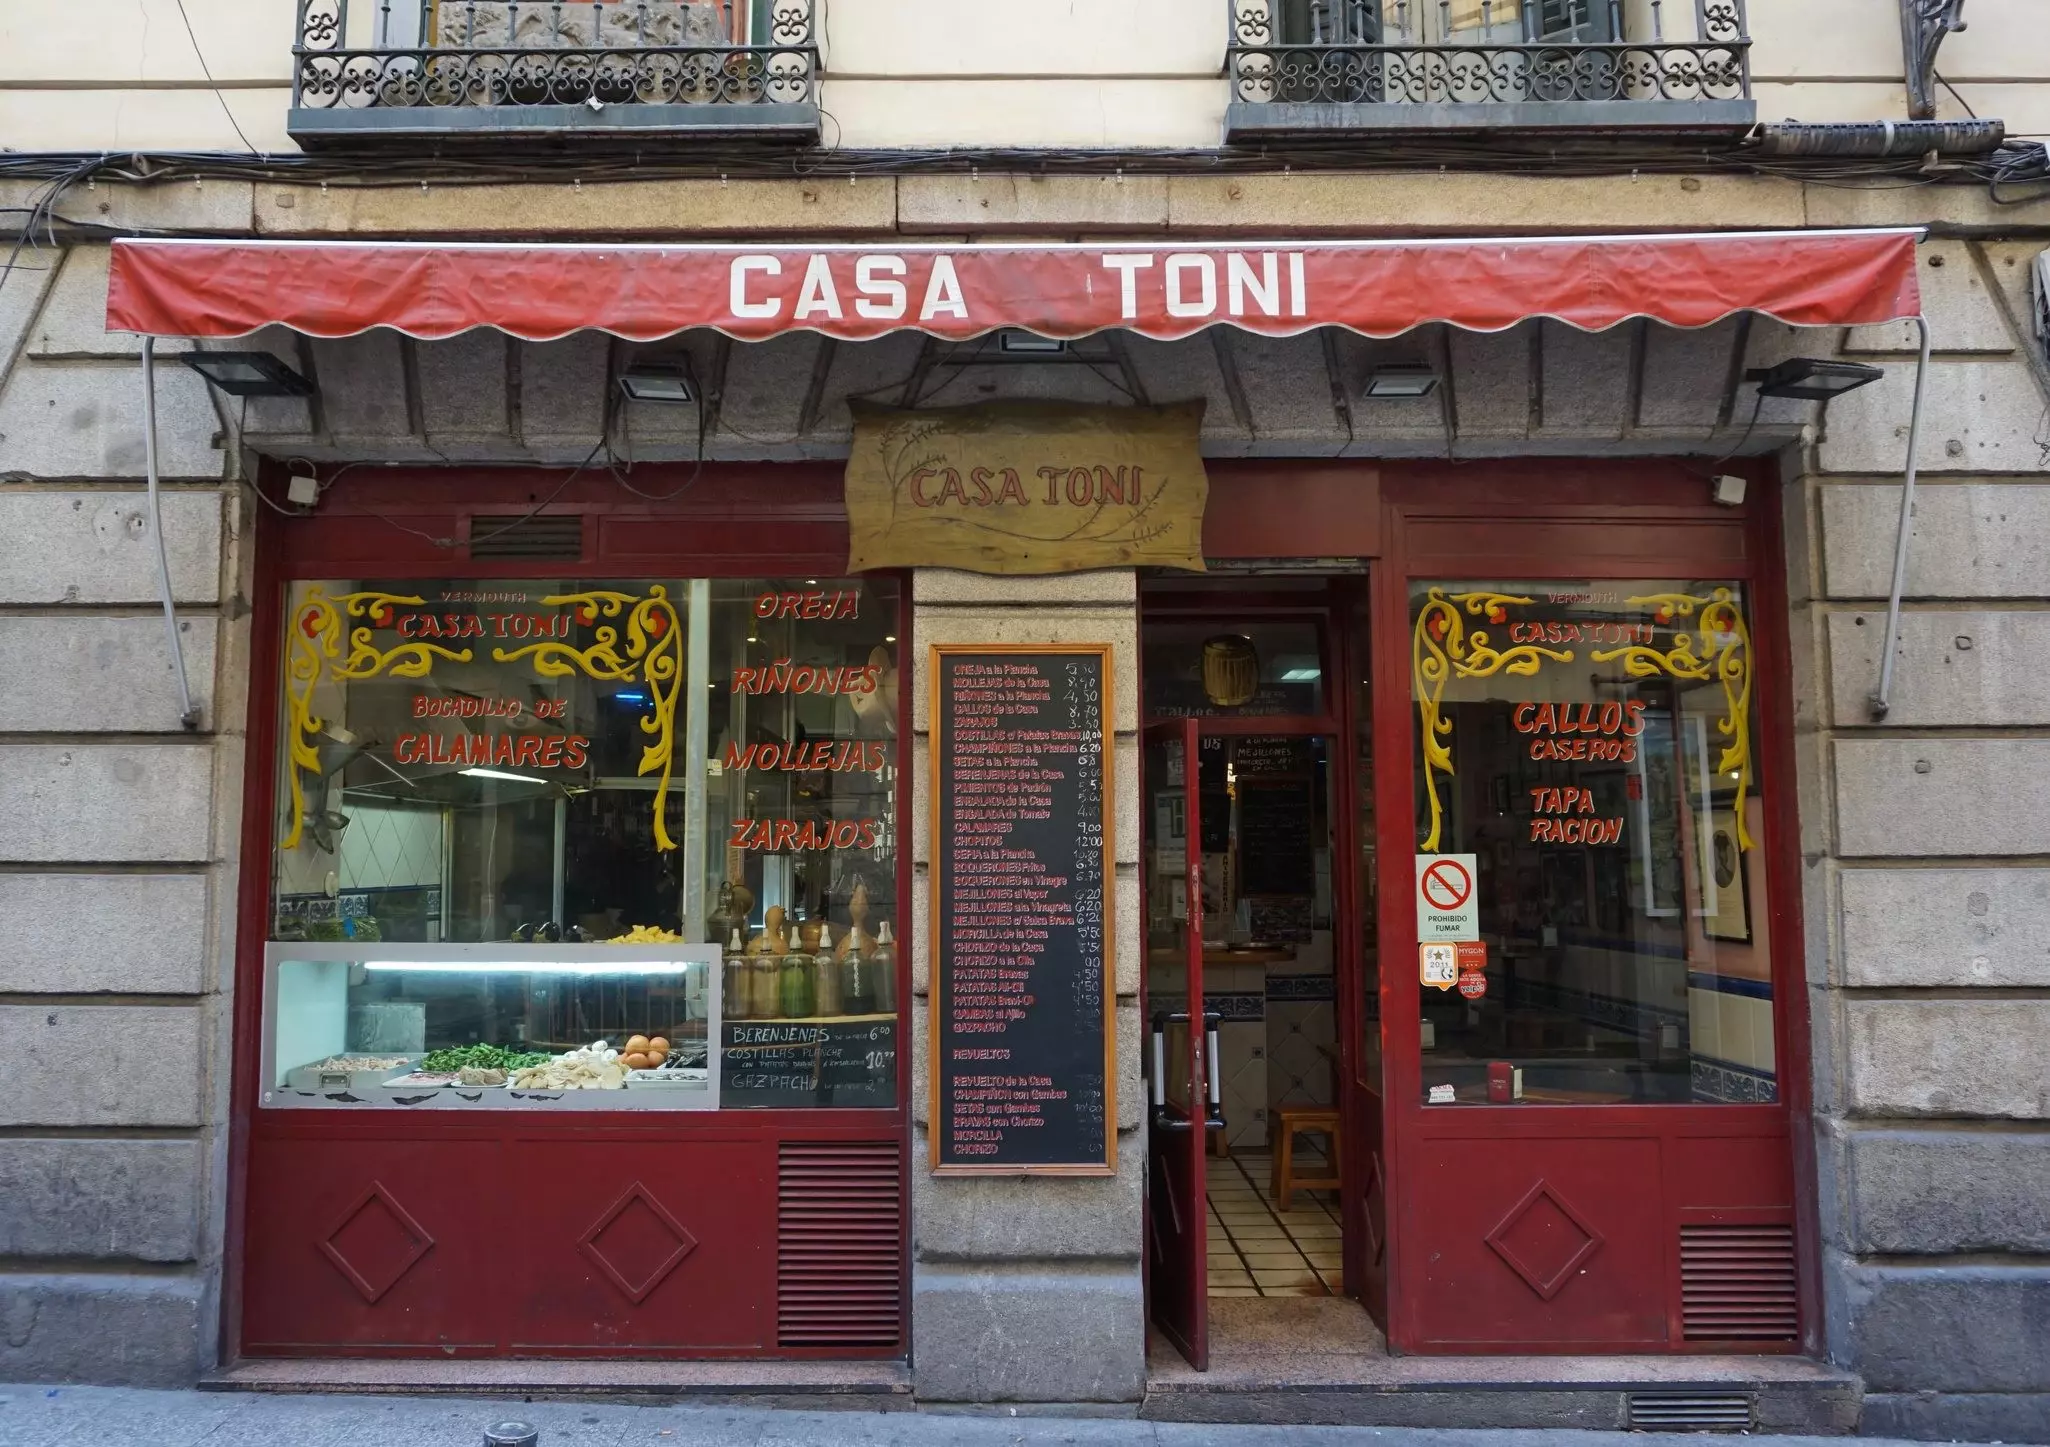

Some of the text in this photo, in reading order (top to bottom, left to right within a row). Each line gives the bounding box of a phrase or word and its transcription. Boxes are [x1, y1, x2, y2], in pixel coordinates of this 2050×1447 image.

[730, 252, 1306, 320] CASA TONI
[910, 465, 1144, 507] CASA TONI
[441, 592, 527, 603] VERMOUTH
[1548, 591, 1618, 604] VERMOUTH
[754, 591, 860, 619] OREJA
[397, 614, 571, 638] CASA TONI
[1509, 622, 1656, 644] CASA TONI
[731, 657, 882, 695] RIÑONES
[954, 677, 1003, 689] MOLLEJAS
[412, 695, 567, 718] BOCADILLO DE
[954, 703, 992, 715] CALLOS
[1512, 701, 1647, 736] CALLOS
[954, 729, 1006, 742] COSTILLAS
[393, 732, 590, 769] CALAMARES
[724, 740, 887, 772] MOLLEJAS
[1530, 739, 1639, 762] CASEROS
[954, 756, 985, 768] SETAS
[1040, 769, 1064, 781] Casa
[954, 796, 1005, 807] ENSALADA
[1029, 796, 1051, 807] Casa
[1530, 786, 1595, 814] TAPA
[954, 809, 1005, 820] ENSALADA
[954, 822, 1012, 834] CALAMARES
[1530, 816, 1623, 844] RACION
[729, 819, 878, 850] ZARAJOS
[954, 835, 1003, 847] CHOPITOS
[954, 861, 1021, 873] BOQUERONES
[954, 875, 1021, 887] BOQUERONES
[954, 888, 1012, 900] MEJILLONES
[954, 902, 1012, 913] MEJILLONES
[954, 915, 1012, 927] MEJILLONES
[954, 928, 1003, 940] MORCILLA
[954, 942, 998, 953] CHORIZO
[954, 955, 998, 967] CHORIZO
[954, 968, 997, 980] PATATAS
[954, 981, 997, 993] PATATAS
[954, 995, 997, 1007] PATATAS
[954, 1021, 1006, 1033] GAZPACHO
[733, 1027, 830, 1043] BERENJENAS
[727, 1047, 795, 1059] COSTILLAS
[954, 1048, 1011, 1060] REVUELTOS
[731, 1074, 818, 1090] GAZPACHO
[954, 1075, 1005, 1087] REVUELTO
[954, 1102, 985, 1114] SETAS
[1010, 1115, 1045, 1128] Chorizo
[954, 1129, 1003, 1141] MORCILLA
[954, 1143, 998, 1155] CHORIZO
